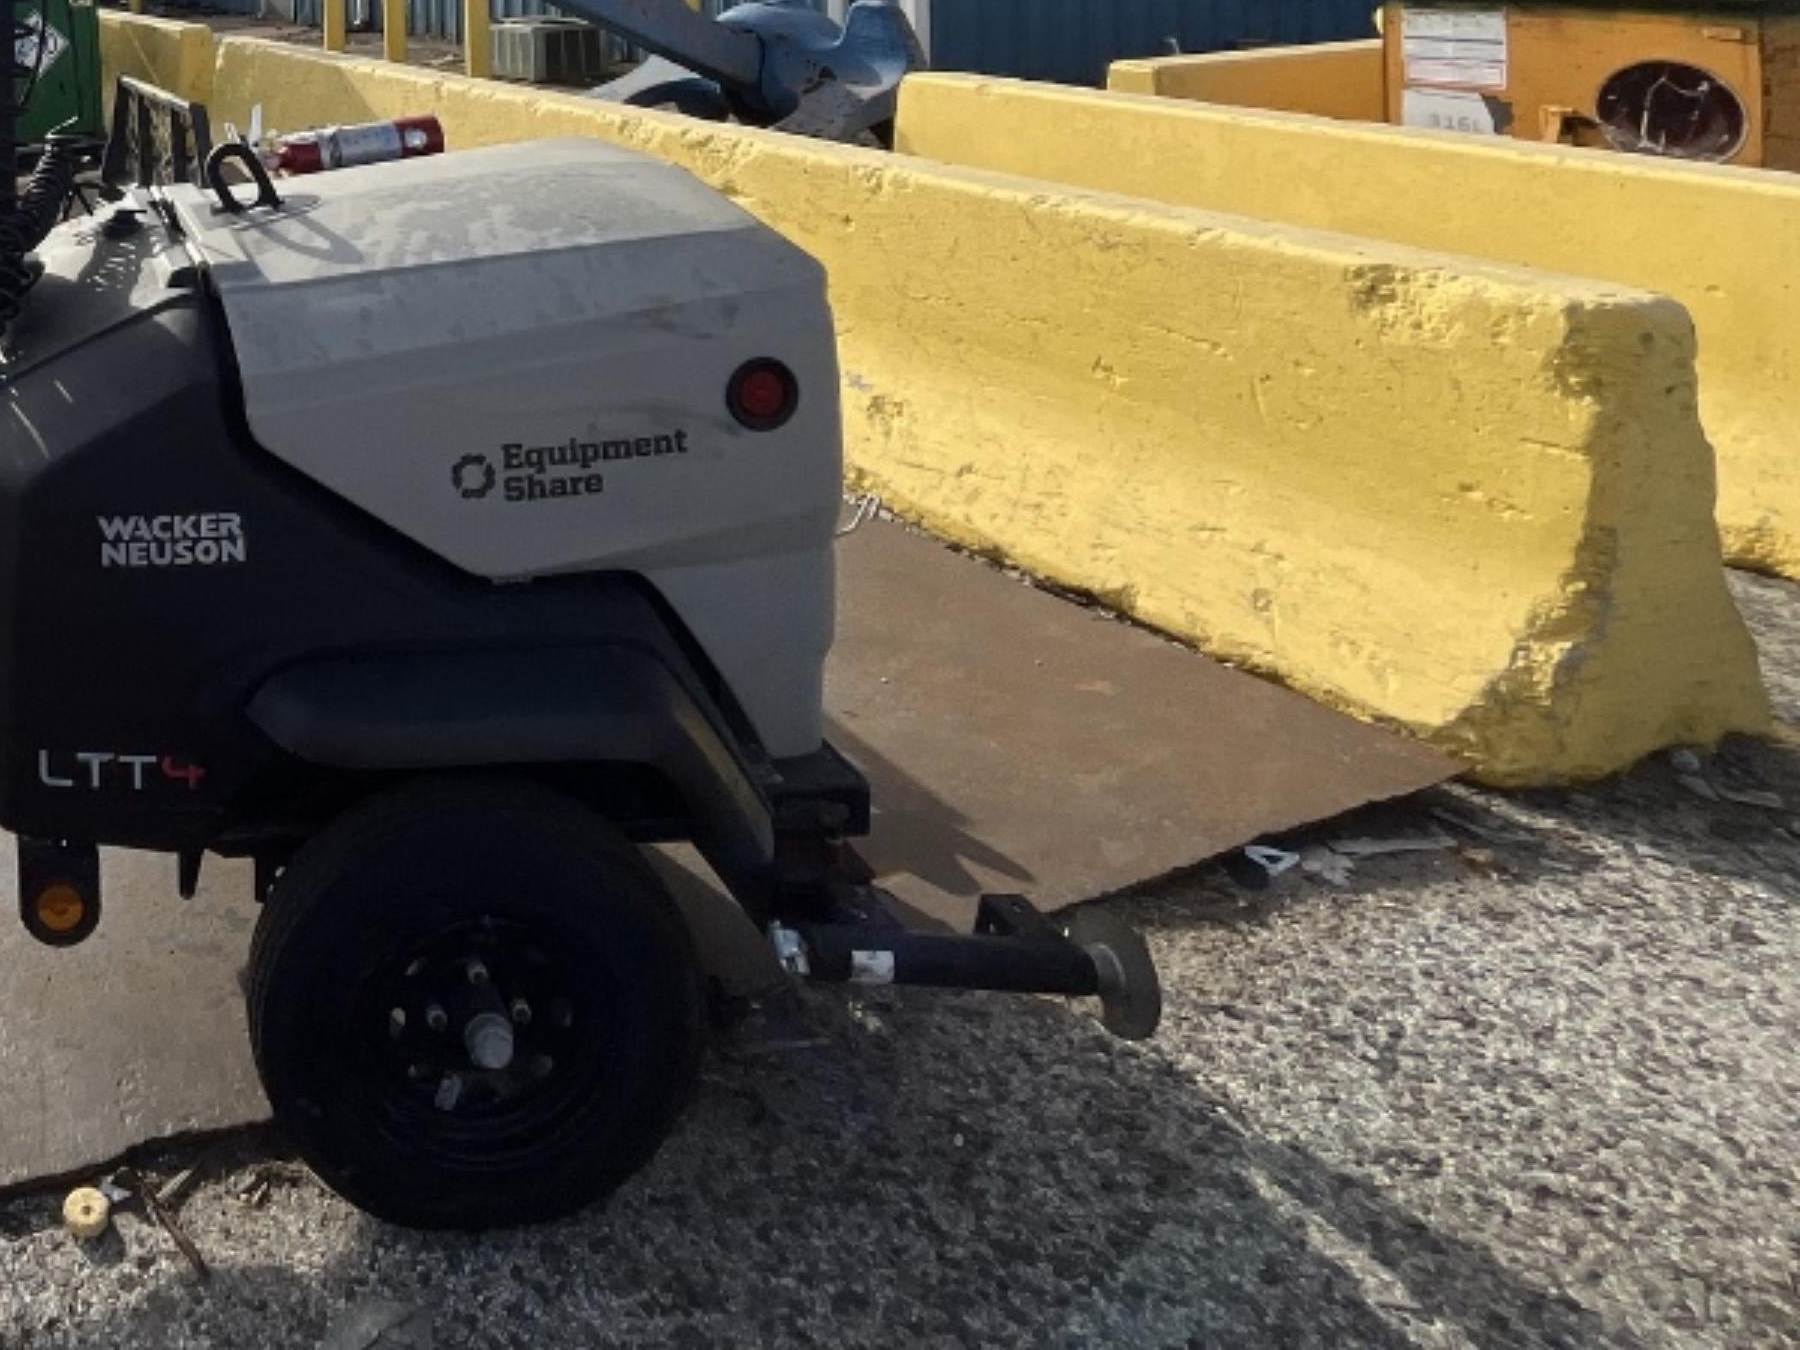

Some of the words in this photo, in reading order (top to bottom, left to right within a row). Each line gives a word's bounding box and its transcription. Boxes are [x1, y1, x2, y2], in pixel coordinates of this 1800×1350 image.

[501, 428, 689, 474] Equipment
[503, 473, 604, 502] Share
[96, 512, 243, 541] WACKER
[101, 535, 247, 568] NEUSON
[38, 749, 206, 791] LTT4
